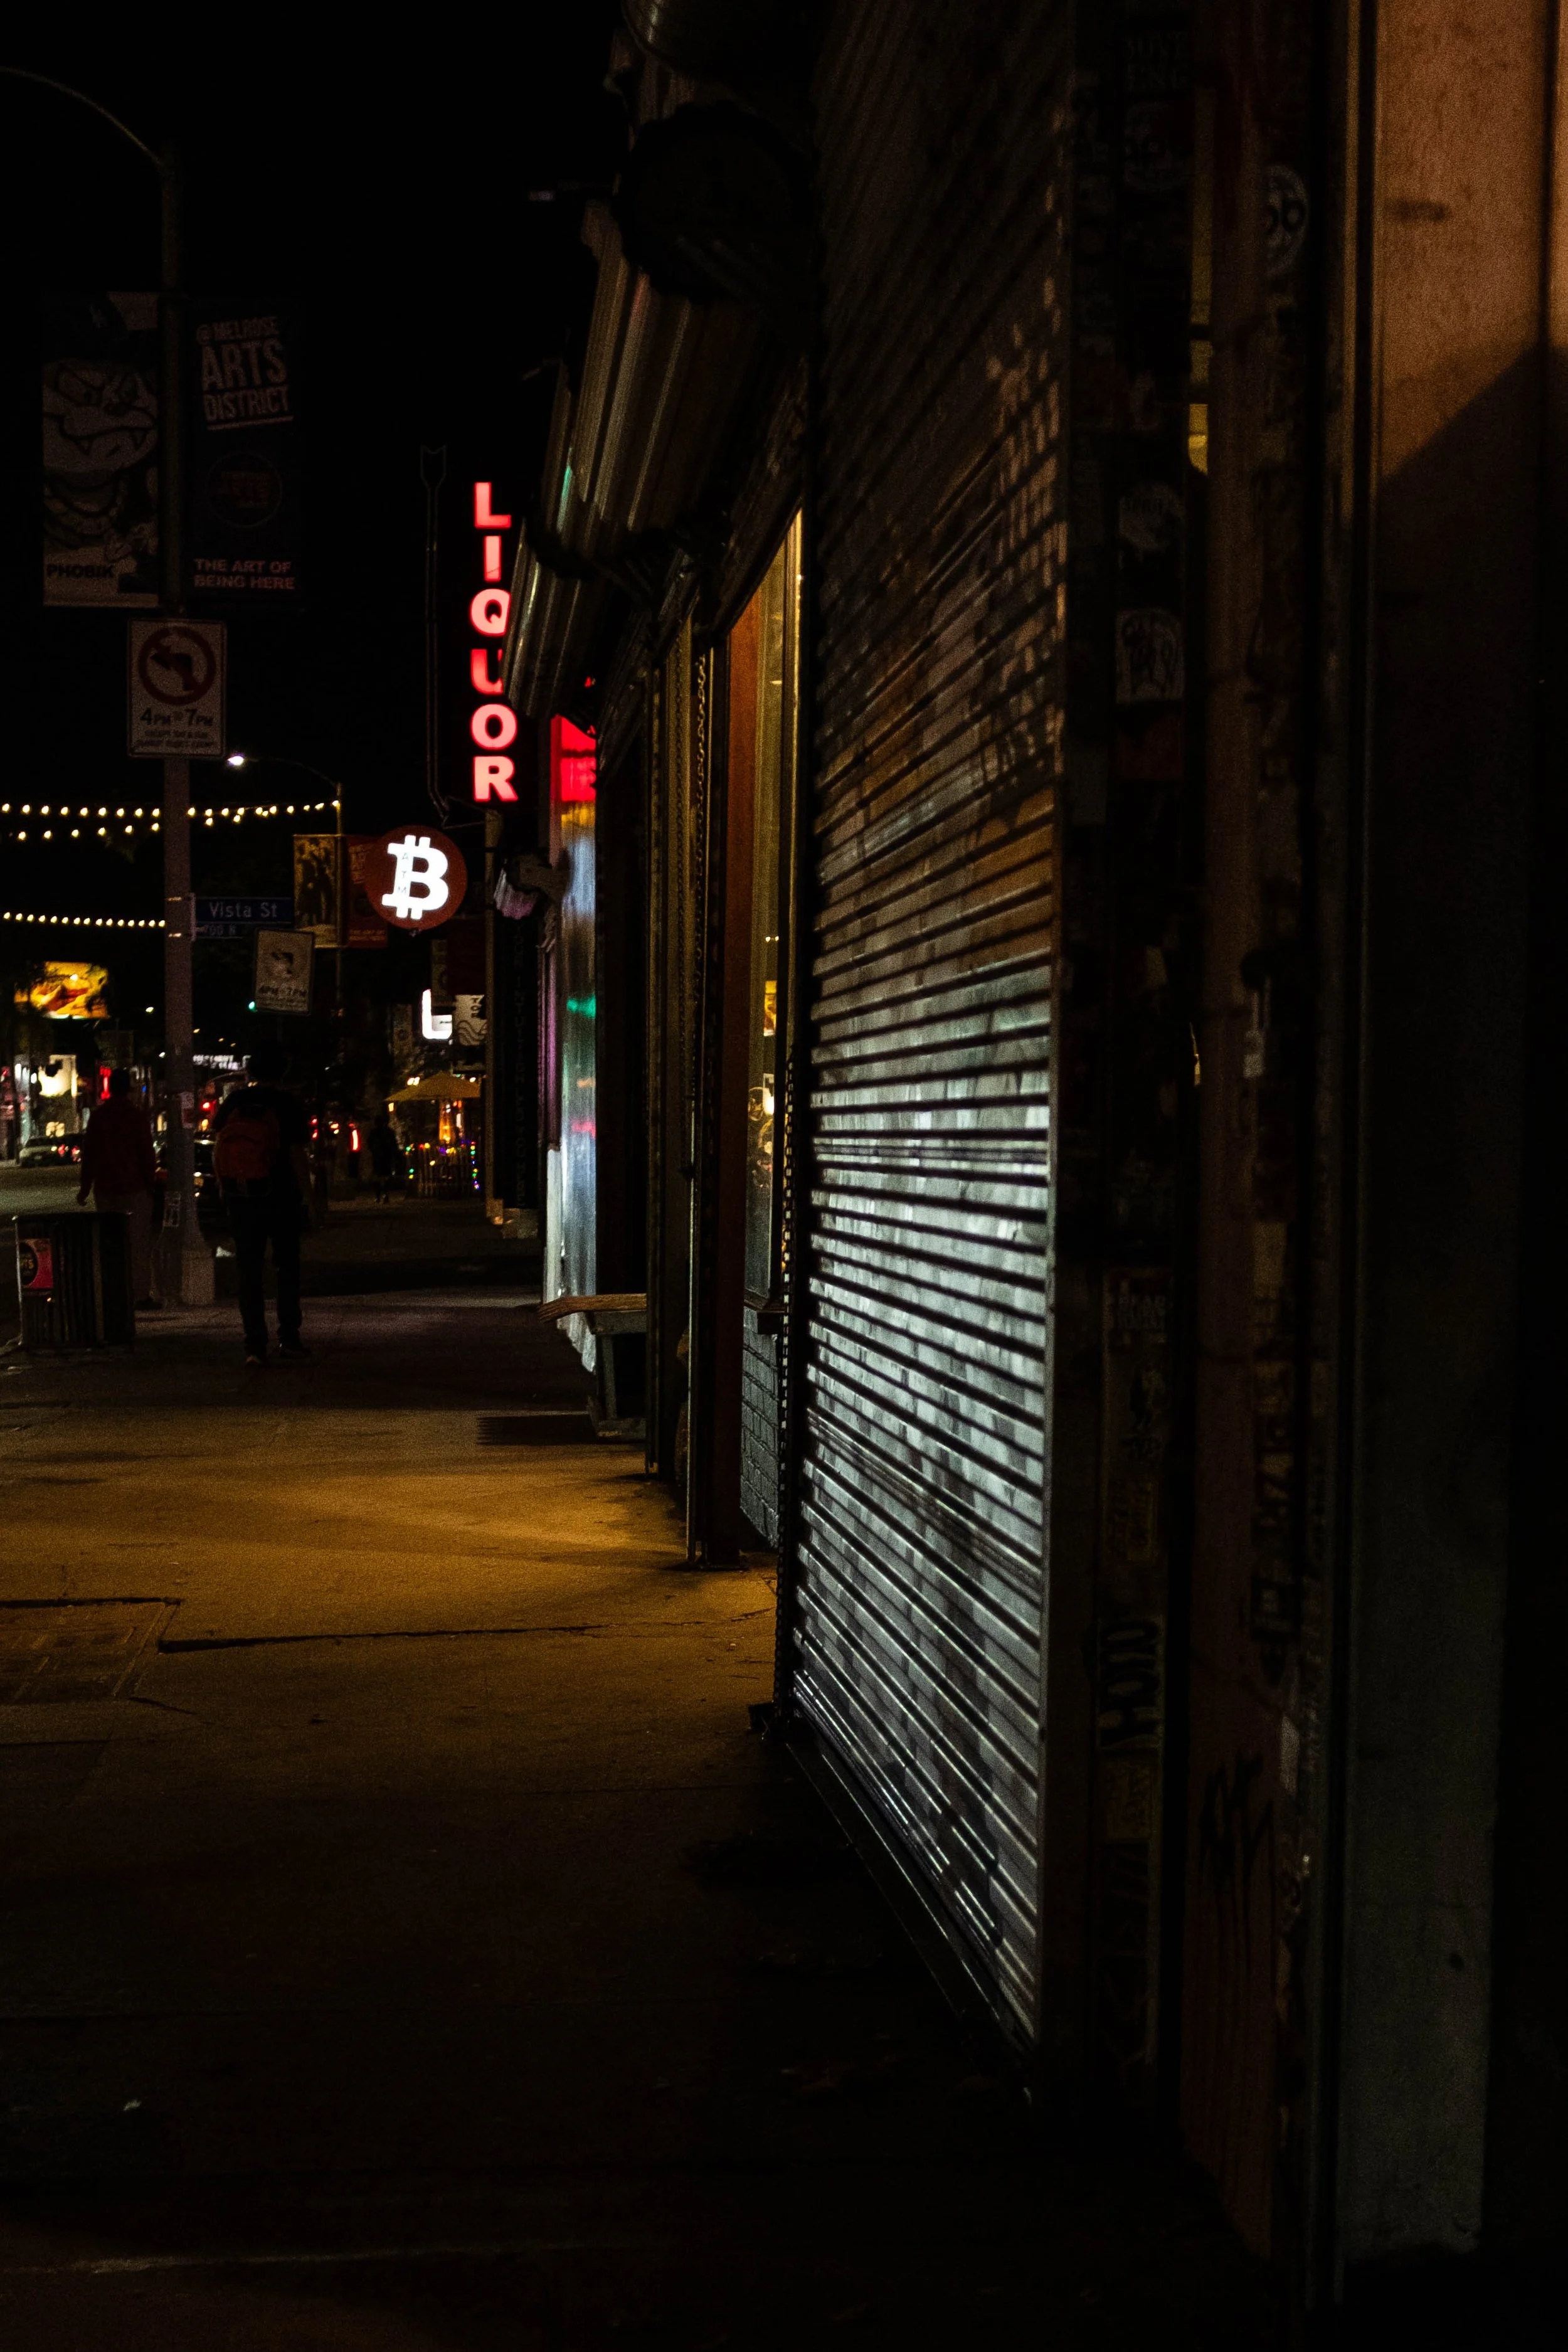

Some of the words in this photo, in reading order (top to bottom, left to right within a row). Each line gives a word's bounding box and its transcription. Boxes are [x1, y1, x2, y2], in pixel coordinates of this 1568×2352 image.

[201, 337, 289, 391] ARTS
[203, 384, 290, 422] DISTRICT
[194, 558, 228, 573] THE
[231, 559, 267, 573] ART
[270, 560, 292, 575] OF
[194, 574, 246, 588] BEING
[250, 575, 297, 590] HERE
[470, 482, 519, 803] LIQUOR
[208, 901, 253, 919] Vista
[260, 901, 278, 919] St
